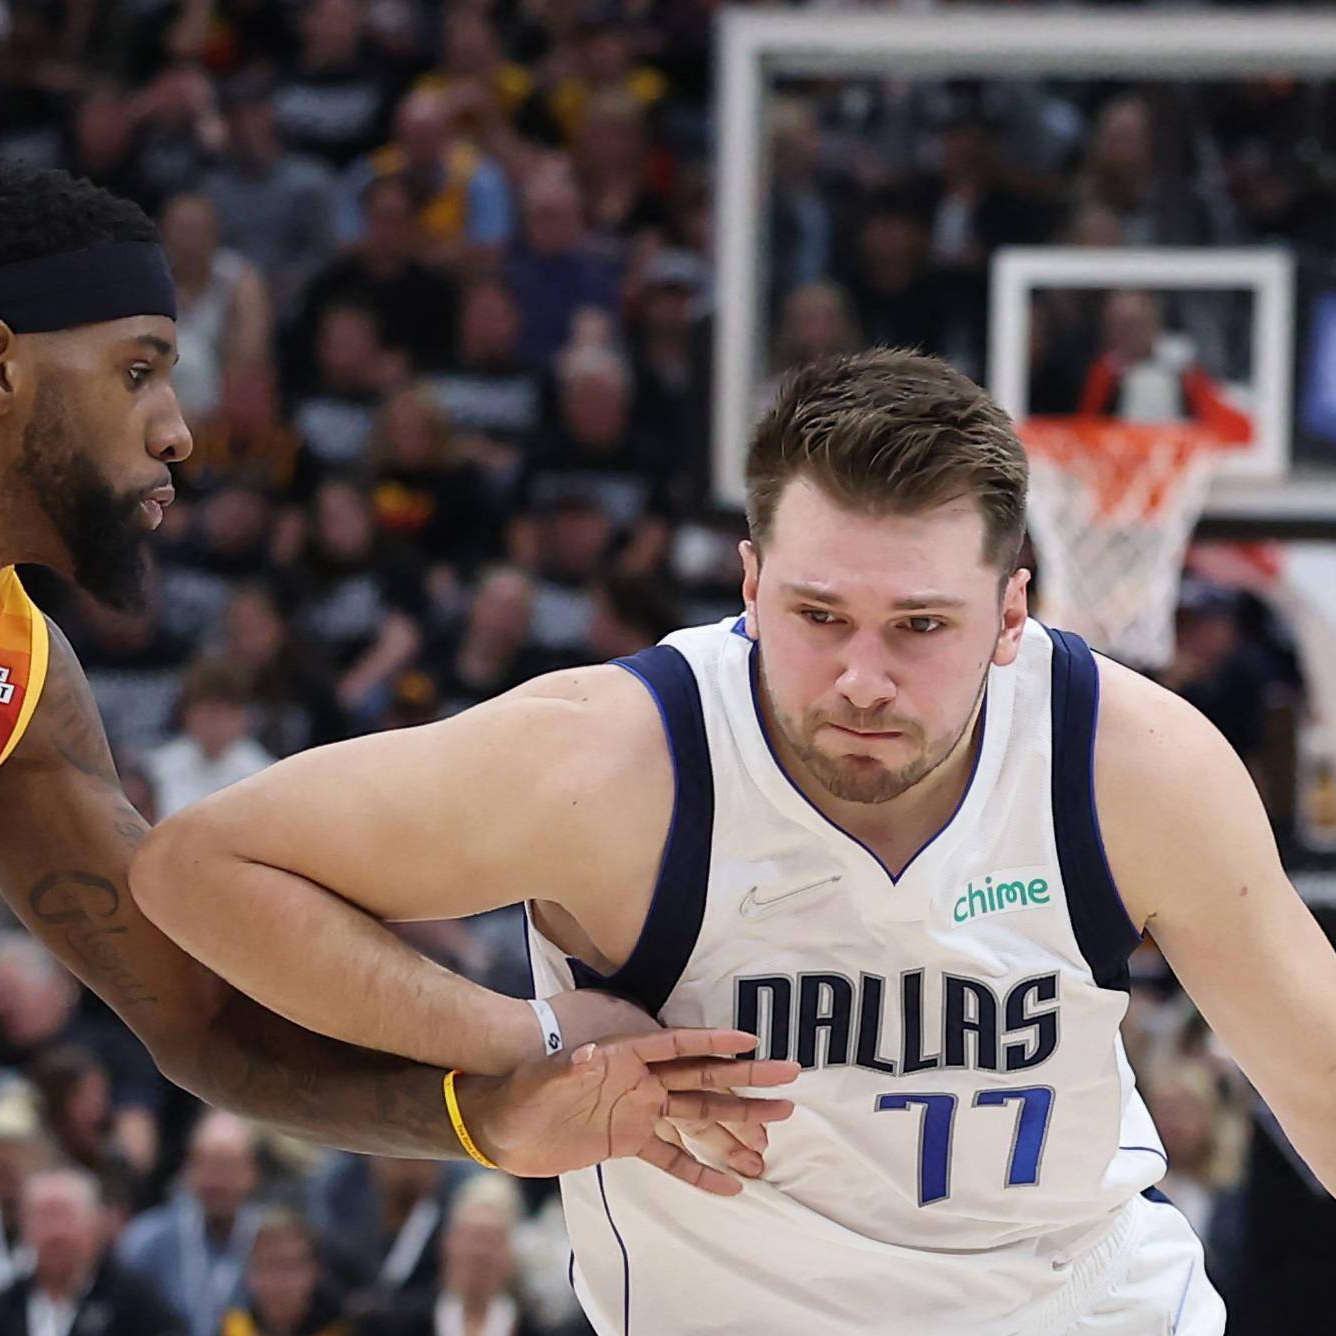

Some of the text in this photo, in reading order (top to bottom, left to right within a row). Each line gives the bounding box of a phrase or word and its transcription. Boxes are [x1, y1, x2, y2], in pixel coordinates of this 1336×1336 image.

[953, 876, 1051, 922] chime
[731, 967, 1062, 1077] DALLAS
[873, 1085, 1056, 1208] 77
